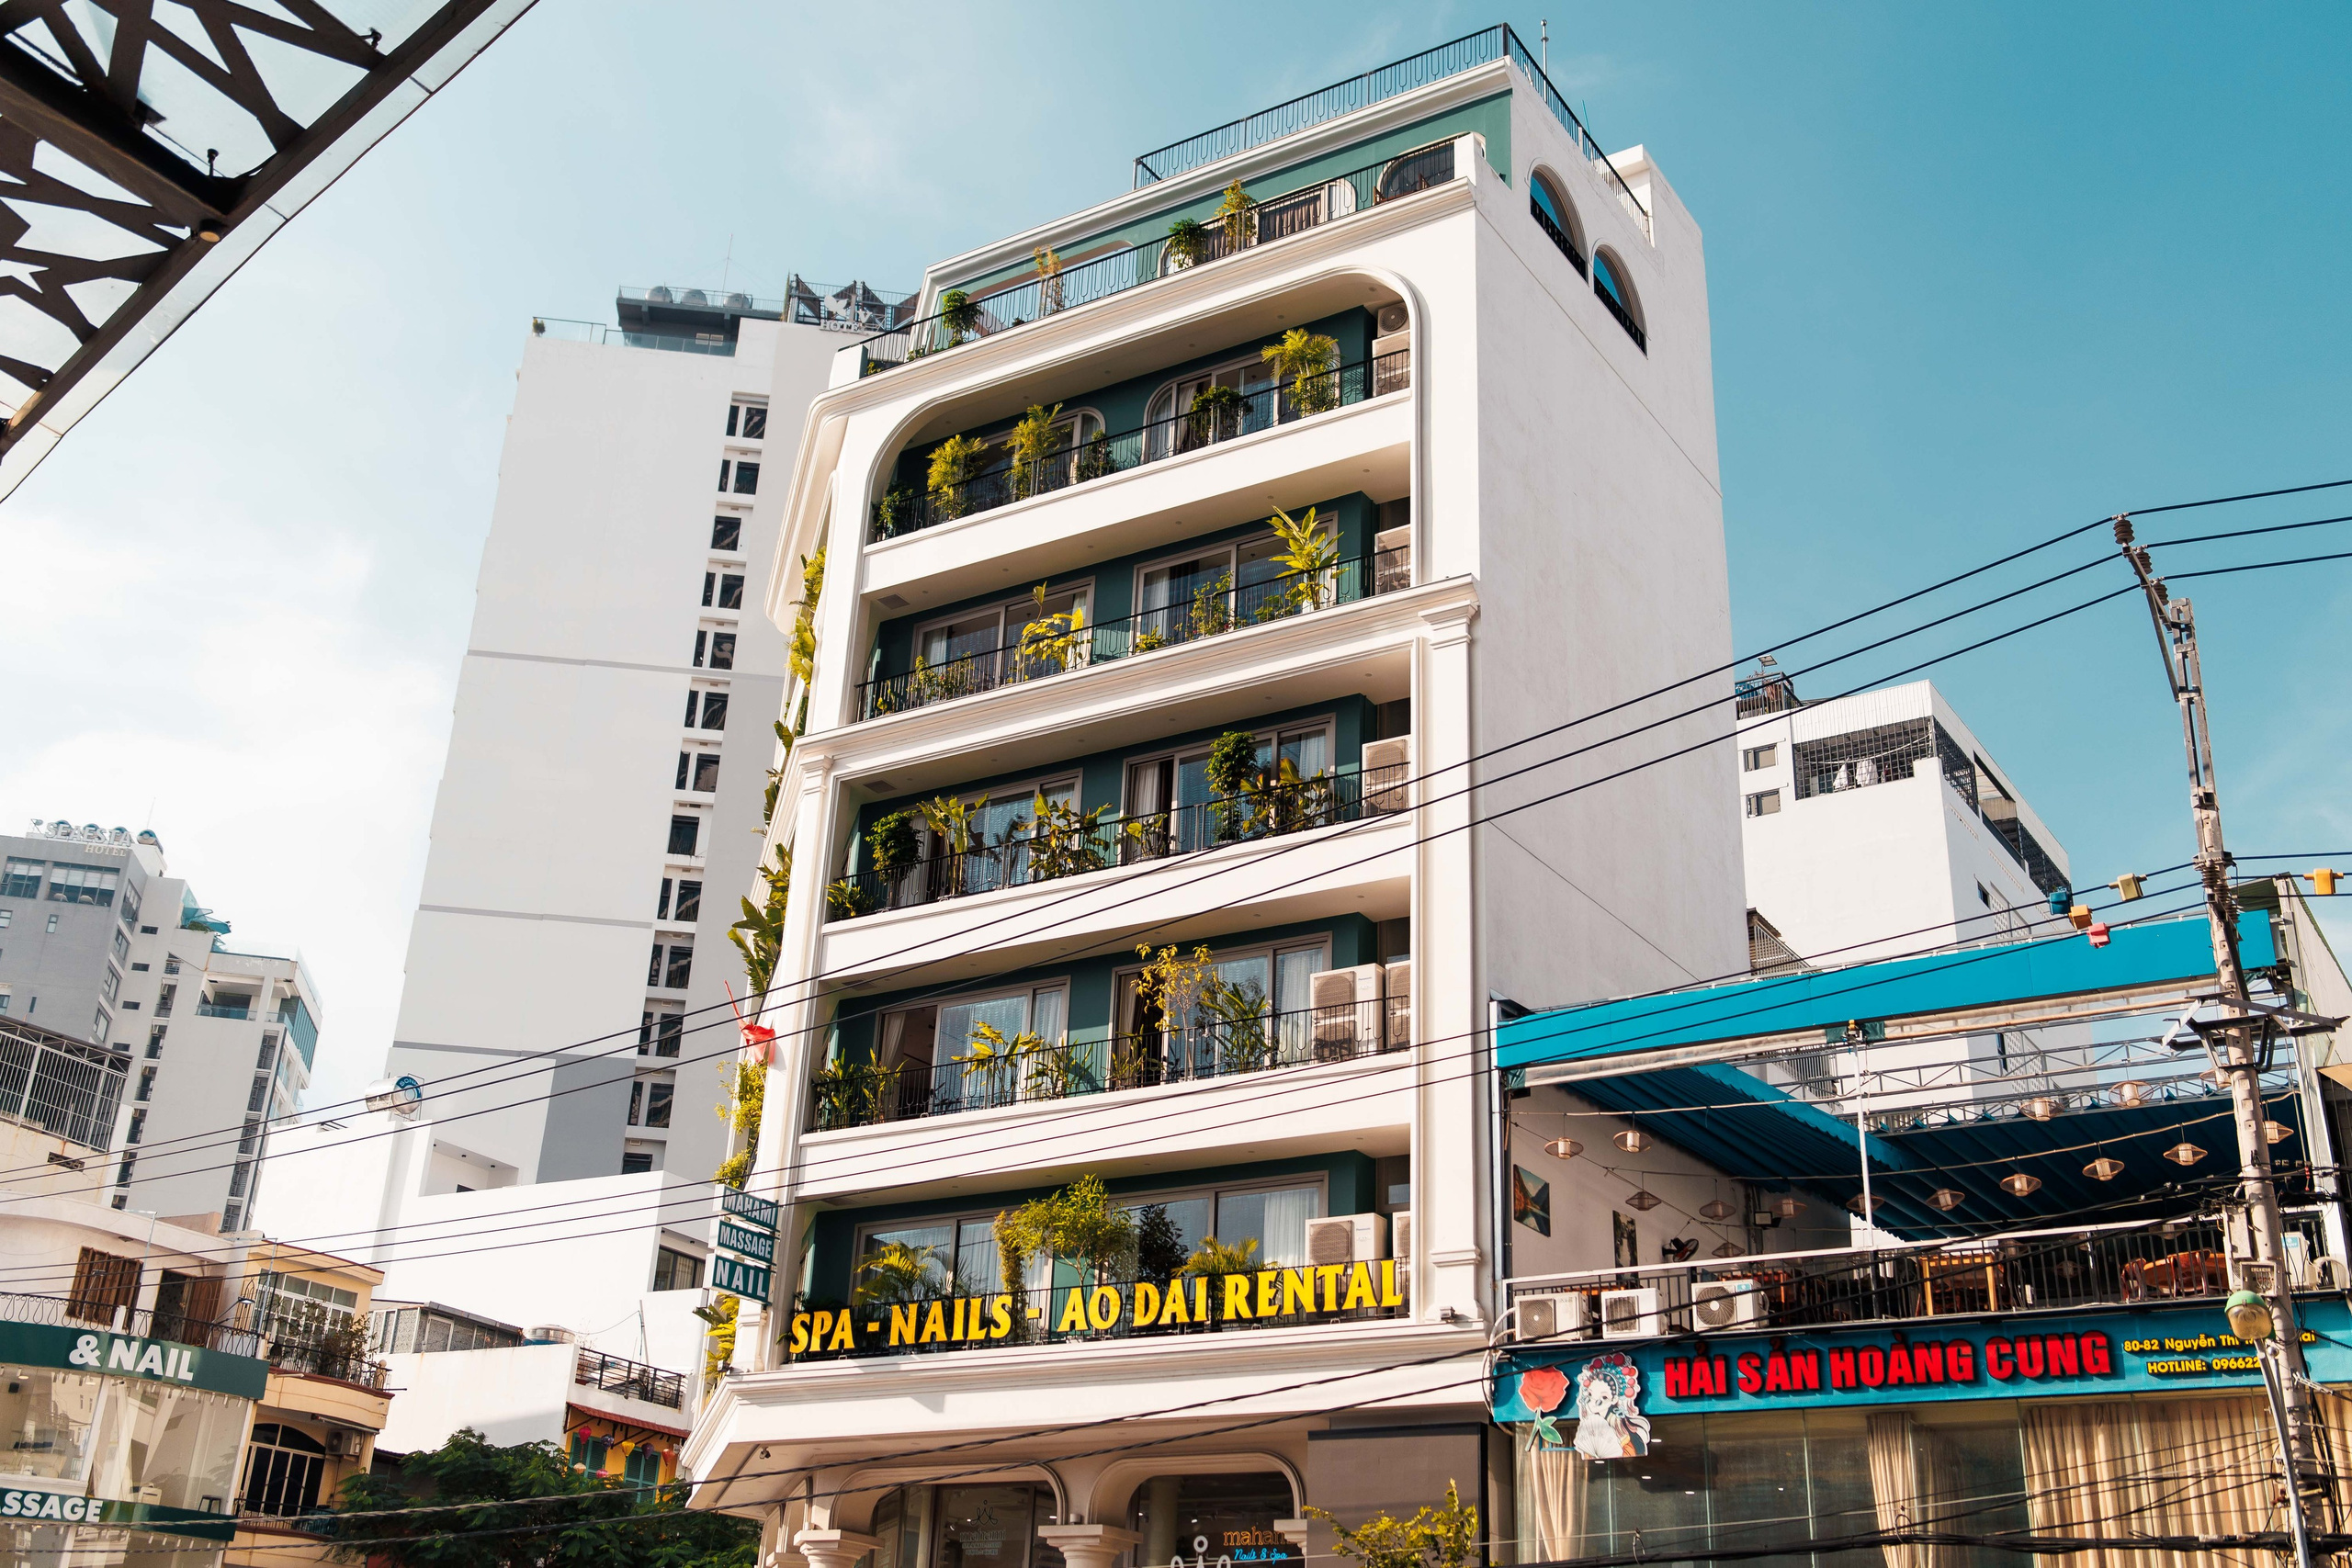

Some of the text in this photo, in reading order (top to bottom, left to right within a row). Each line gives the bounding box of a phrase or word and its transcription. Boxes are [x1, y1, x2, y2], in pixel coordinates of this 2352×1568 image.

[45, 821, 132, 848] SEAESTA
[85, 843, 127, 857] HOTEL
[724, 1189, 776, 1226] MAHAMI
[719, 1224, 773, 1259] MASSAGE
[715, 1259, 766, 1298] NAIL
[789, 1309, 855, 1354] SPA
[888, 1295, 1012, 1347] NAILS
[1057, 1286, 1122, 1332] AO
[1132, 1277, 1209, 1327] DAI
[1223, 1259, 1404, 1321] RENTAL
[69, 1334, 194, 1382] & NAIL
[2123, 1339, 2160, 1352] 80-82
[2165, 1334, 2216, 1353] Nguyễn
[1664, 1330, 2112, 1398] HẢI SẢN HOÀNG CUNG
[2147, 1356, 2261, 1374] HOTLINE: 096622
[0, 1491, 104, 1523] SSAGE
[1234, 1548, 1258, 1561] Nails
[1270, 1547, 1289, 1565] Spa
